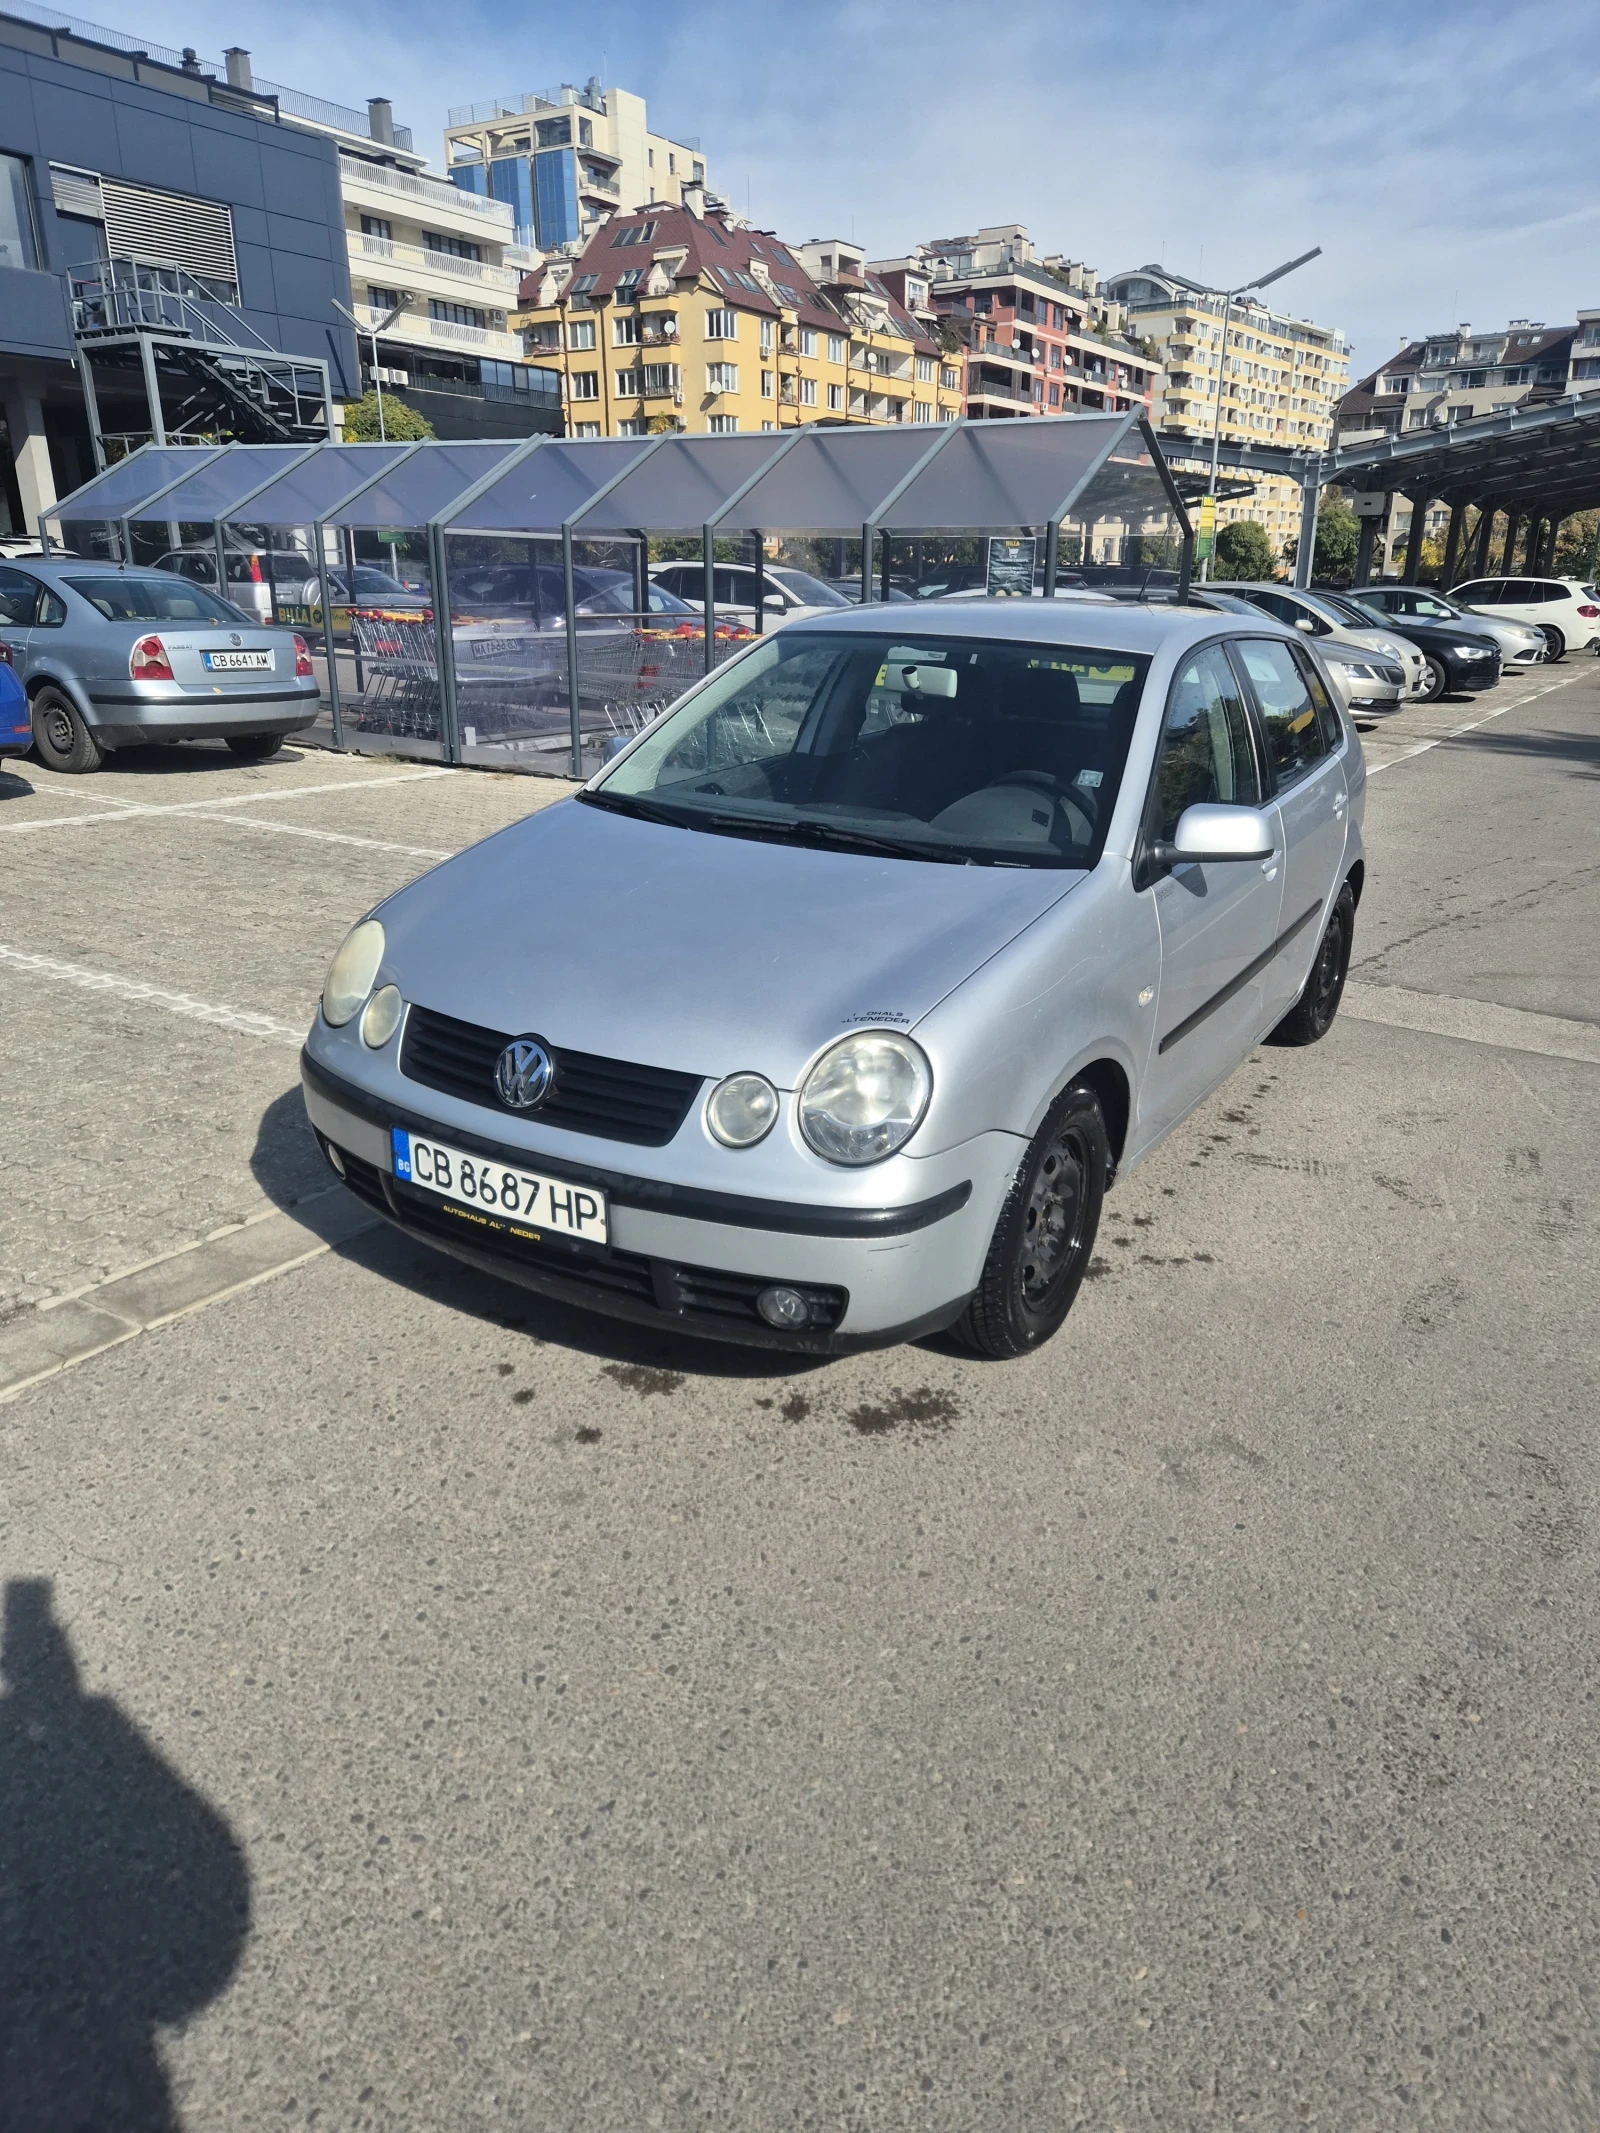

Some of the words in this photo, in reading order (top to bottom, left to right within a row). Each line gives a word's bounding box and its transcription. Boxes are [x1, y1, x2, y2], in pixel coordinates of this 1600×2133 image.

[278, 607, 309, 624] BILLA
[212, 655, 228, 667] CB
[229, 654, 254, 667] 6641
[256, 654, 270, 667] AM
[841, 1016, 910, 1024] LTENEDER
[398, 1158, 411, 1173] BG
[414, 1142, 453, 1190] CB
[460, 1159, 541, 1216] 8687
[549, 1184, 598, 1231] HP
[443, 1205, 487, 1225] AUTOHAUS
